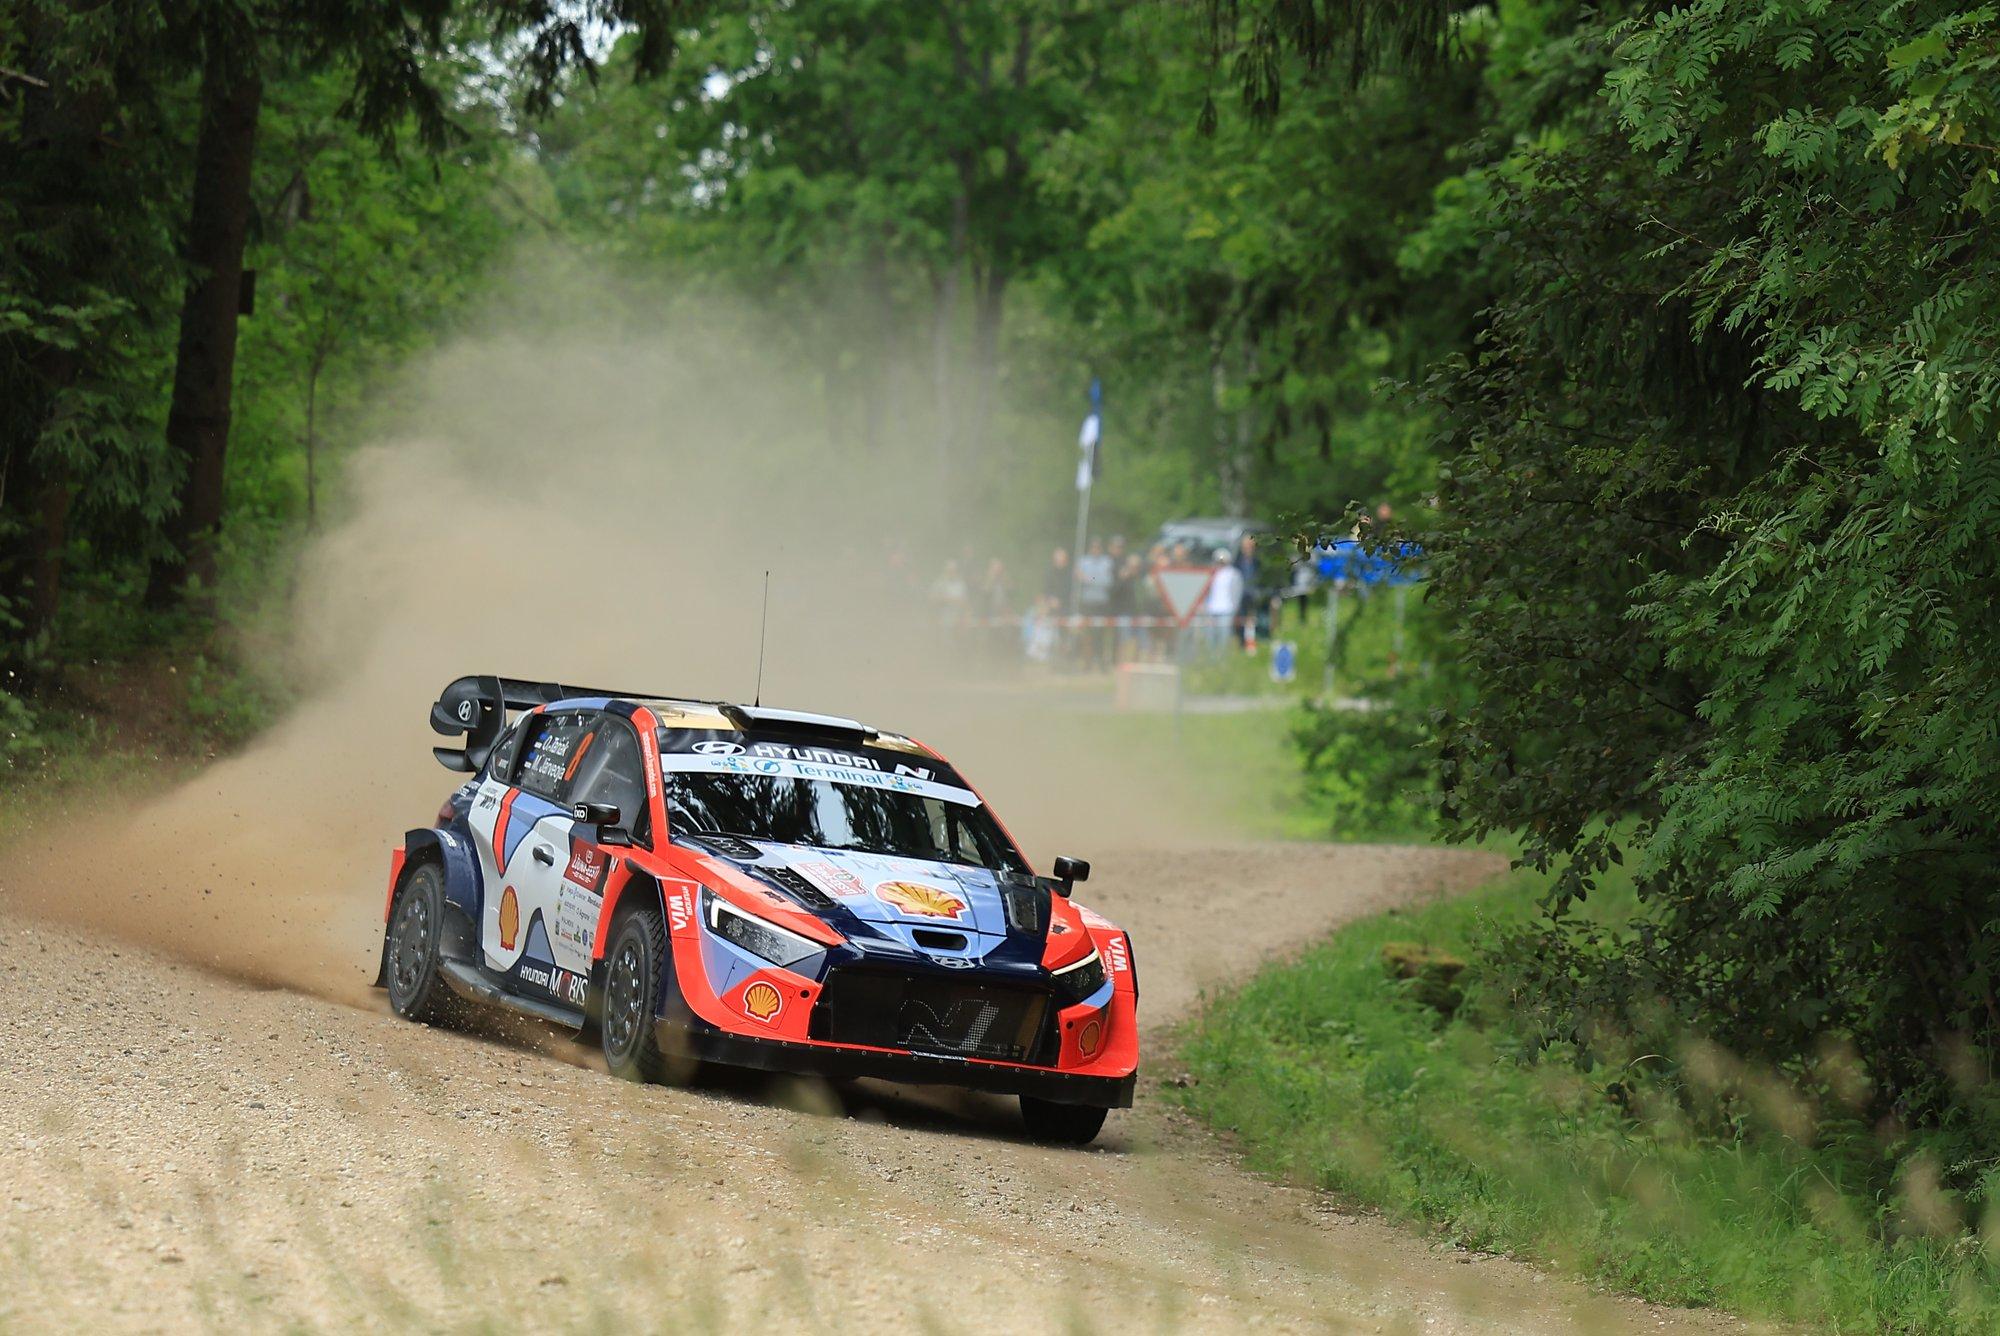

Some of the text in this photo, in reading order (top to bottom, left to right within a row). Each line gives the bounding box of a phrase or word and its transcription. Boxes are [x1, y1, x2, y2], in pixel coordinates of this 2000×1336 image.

[753, 744, 881, 771] HYUNDAI
[792, 763, 883, 785] Terminal
[520, 964, 589, 1007] HYUNDAI MOBIS
